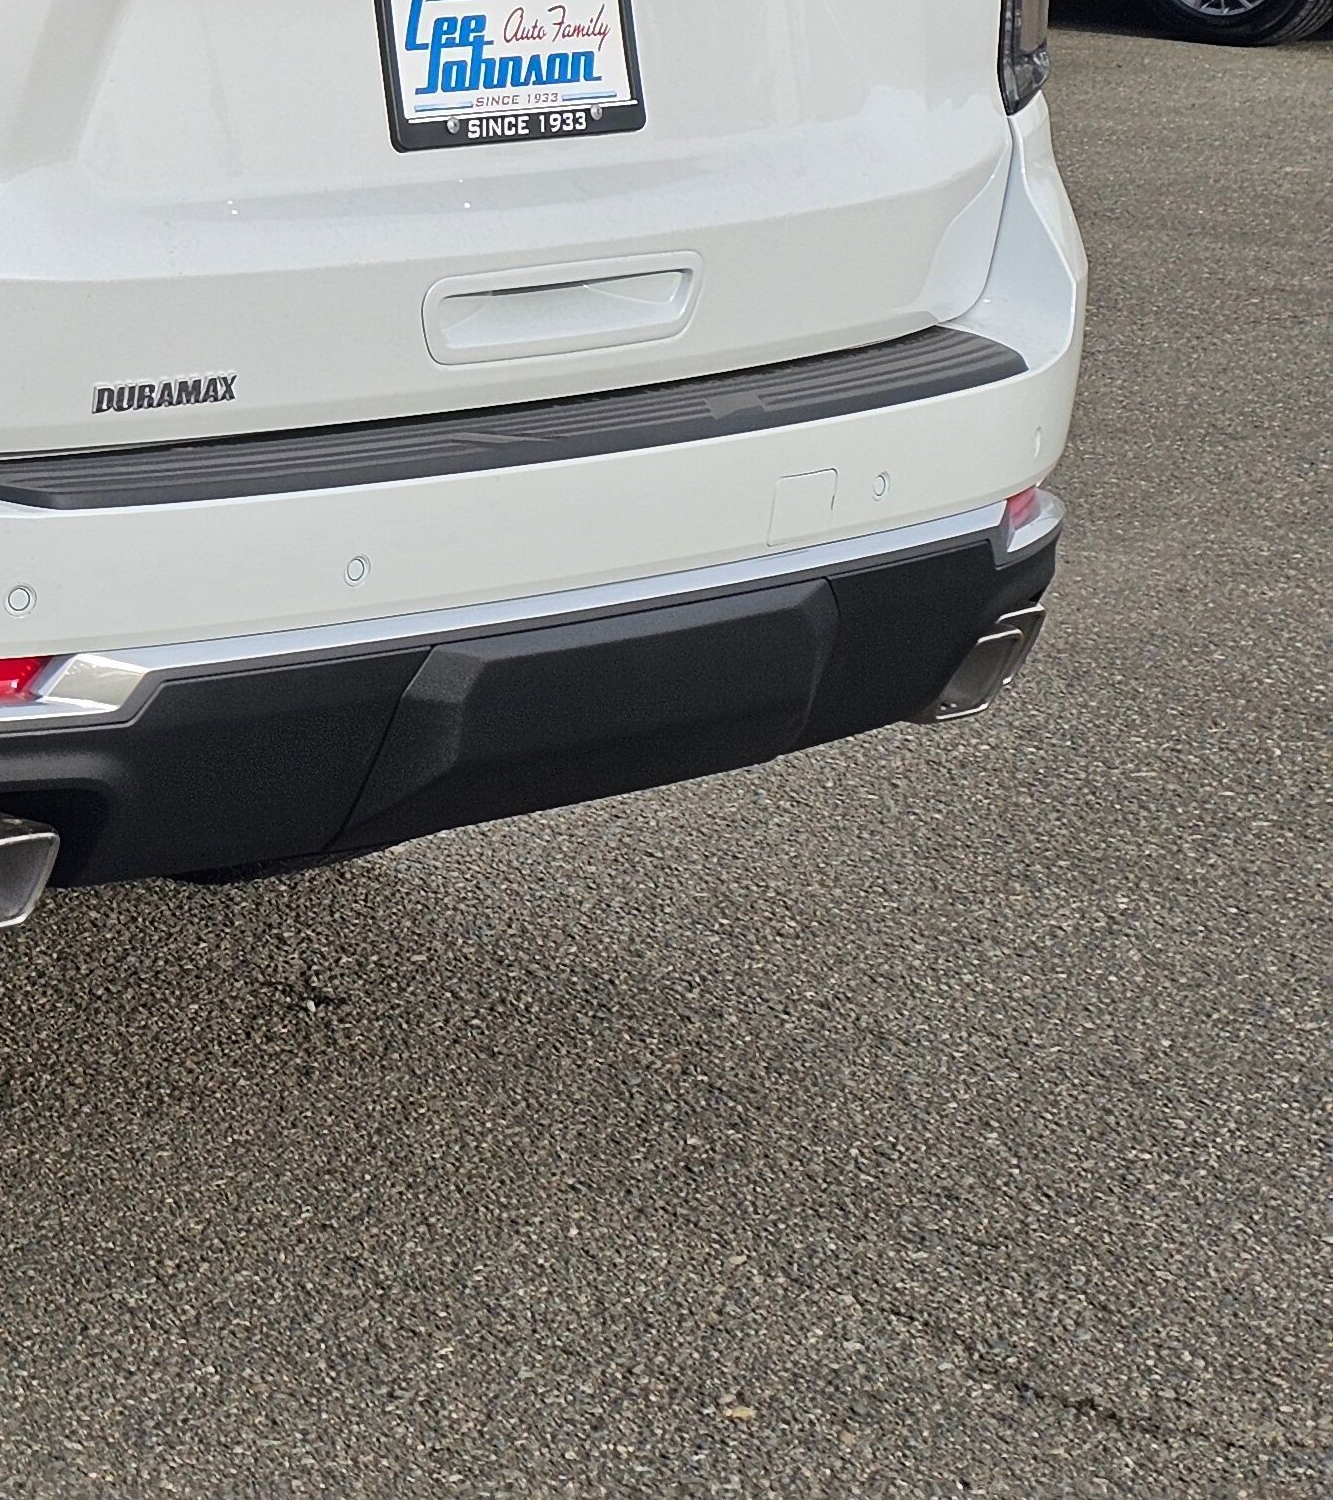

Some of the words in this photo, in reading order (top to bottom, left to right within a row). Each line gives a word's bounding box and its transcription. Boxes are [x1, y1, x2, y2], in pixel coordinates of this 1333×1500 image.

[503, 7, 547, 44] Auto
[547, 4, 612, 51] Family
[415, 35, 603, 95] Johnson
[475, 94, 521, 108] SINCE
[526, 92, 559, 105] 1933
[467, 116, 530, 139] SINCE
[538, 111, 588, 133] 1933
[91, 373, 238, 414] DURAMAX
